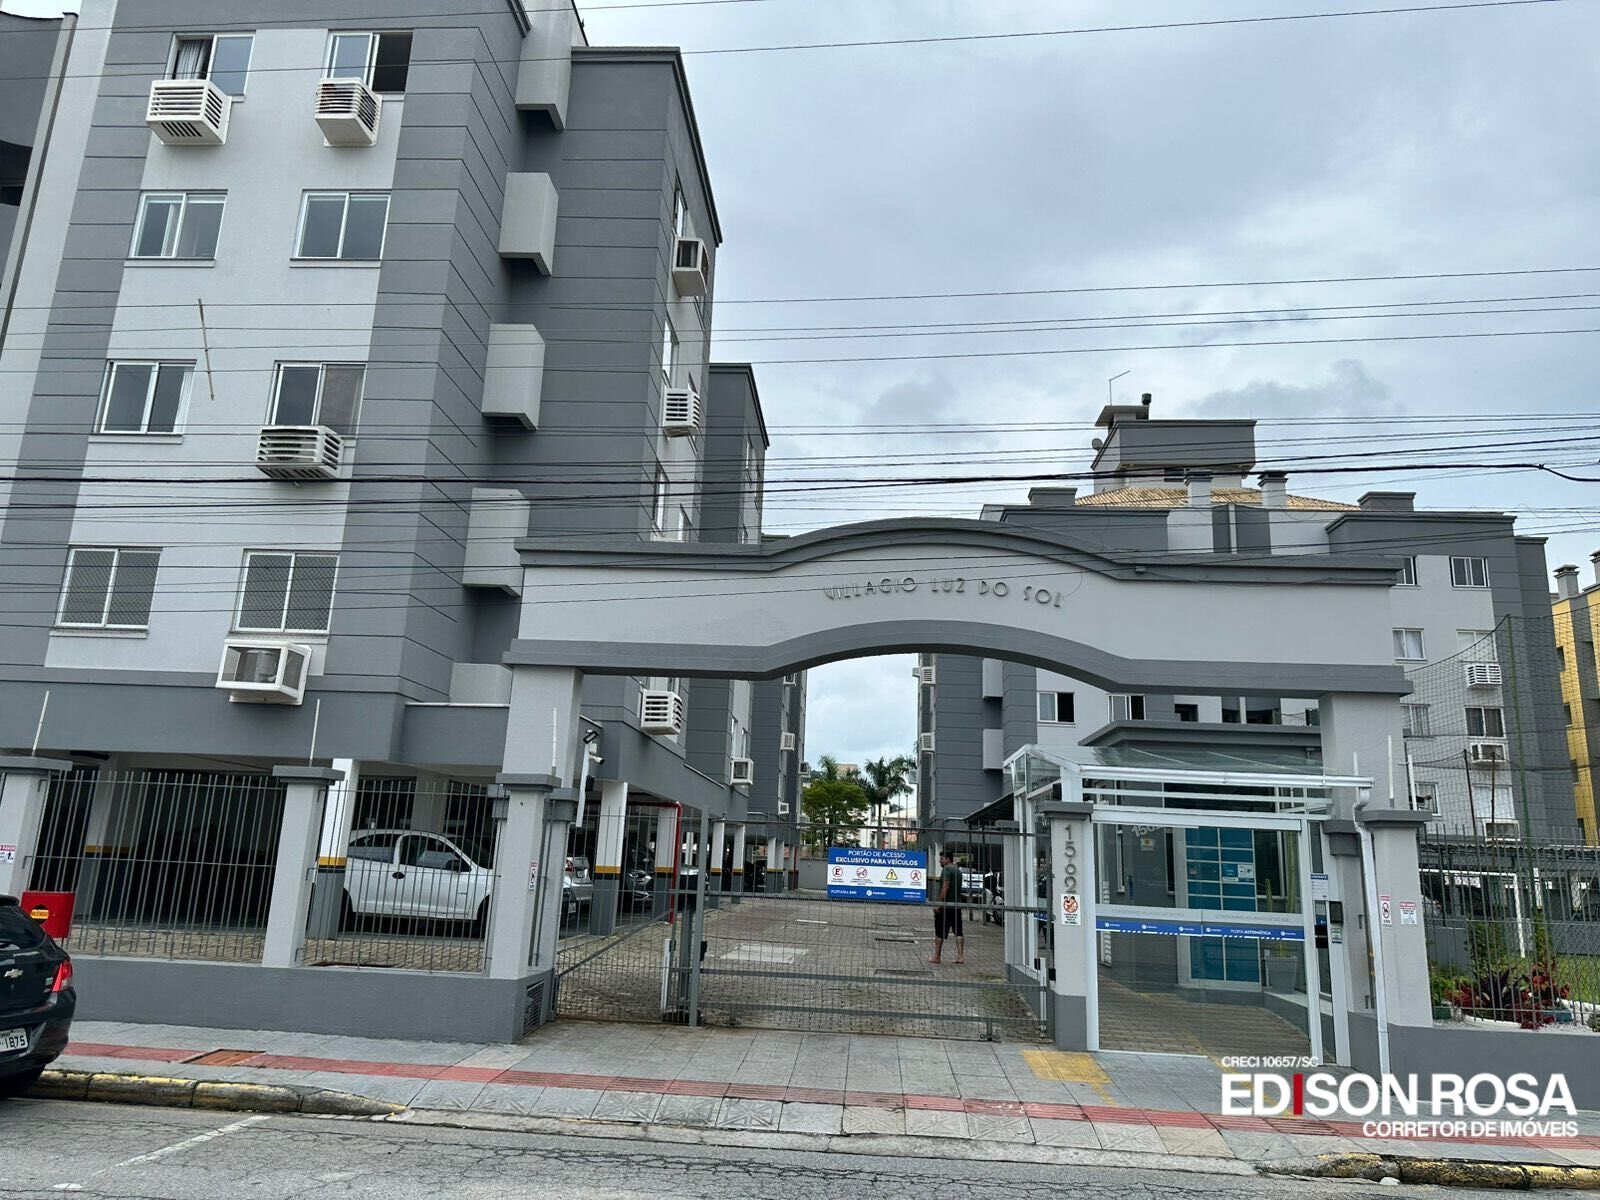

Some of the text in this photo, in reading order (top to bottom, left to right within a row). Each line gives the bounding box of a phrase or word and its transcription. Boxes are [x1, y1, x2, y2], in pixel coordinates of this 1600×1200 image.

[824, 577, 1065, 608] VILLAGIO LUZ DO SOL
[887, 858, 918, 866] VEÍCULOS
